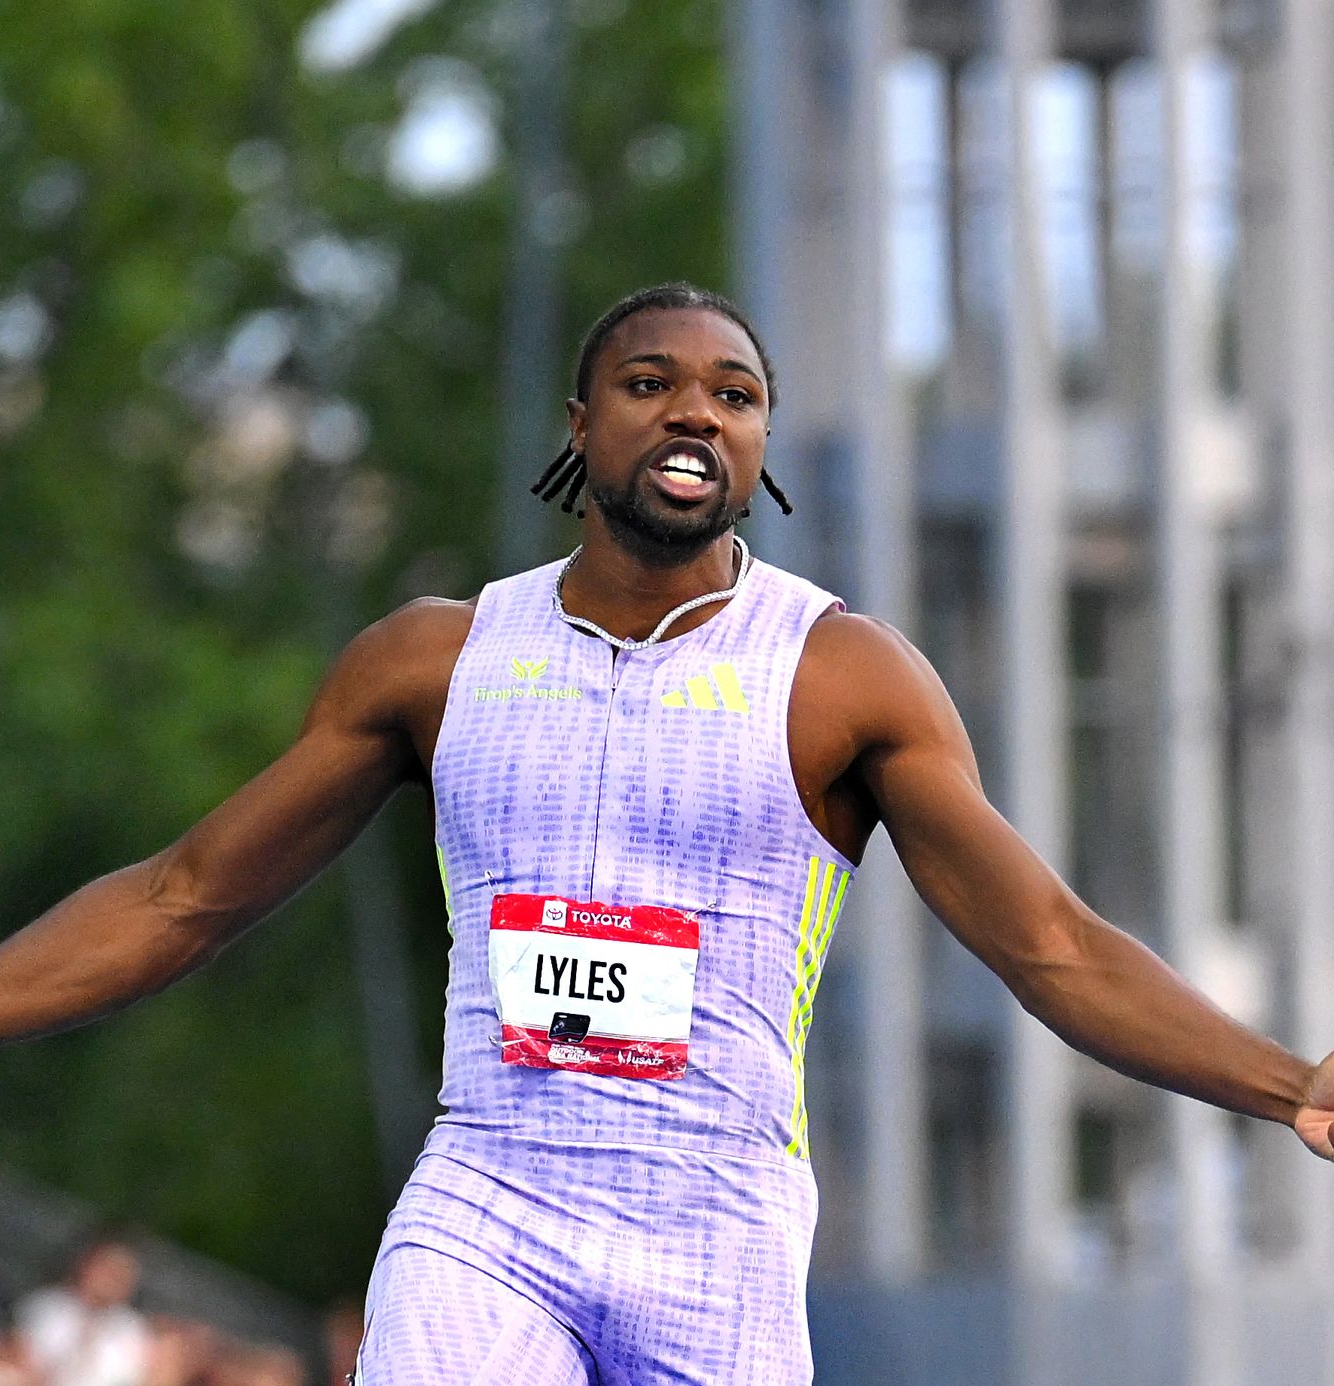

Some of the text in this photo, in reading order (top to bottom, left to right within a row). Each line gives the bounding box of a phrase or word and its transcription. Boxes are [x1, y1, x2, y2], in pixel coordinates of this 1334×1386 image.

[474, 683, 582, 703] Tirop's Angels
[571, 910, 632, 929] TOYOTA
[534, 953, 627, 1003] LYLES
[632, 1056, 664, 1066] USATF
